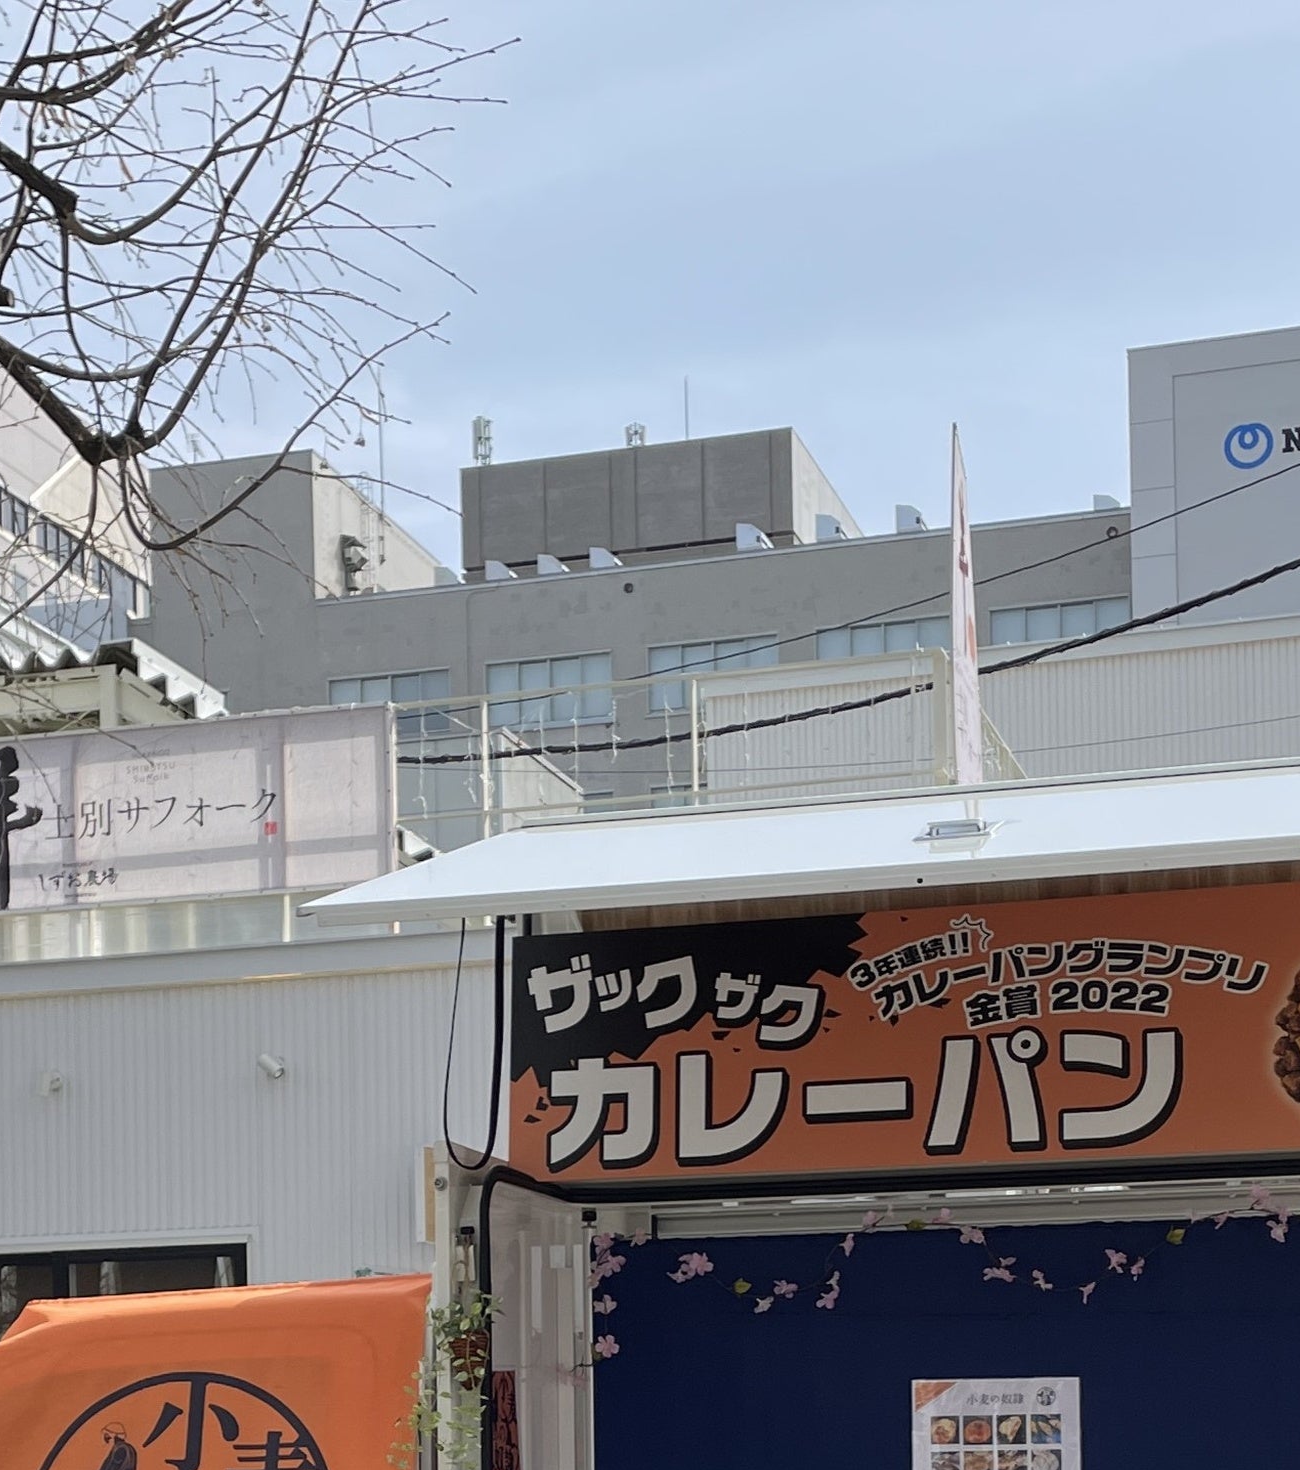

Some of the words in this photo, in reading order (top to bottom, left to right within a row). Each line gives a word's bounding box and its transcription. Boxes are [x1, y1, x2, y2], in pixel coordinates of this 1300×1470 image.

[873, 939, 1271, 1020] カレーパングランプリ
[1050, 979, 1171, 1015] 2022
[544, 1026, 1185, 1174] カレーパン
